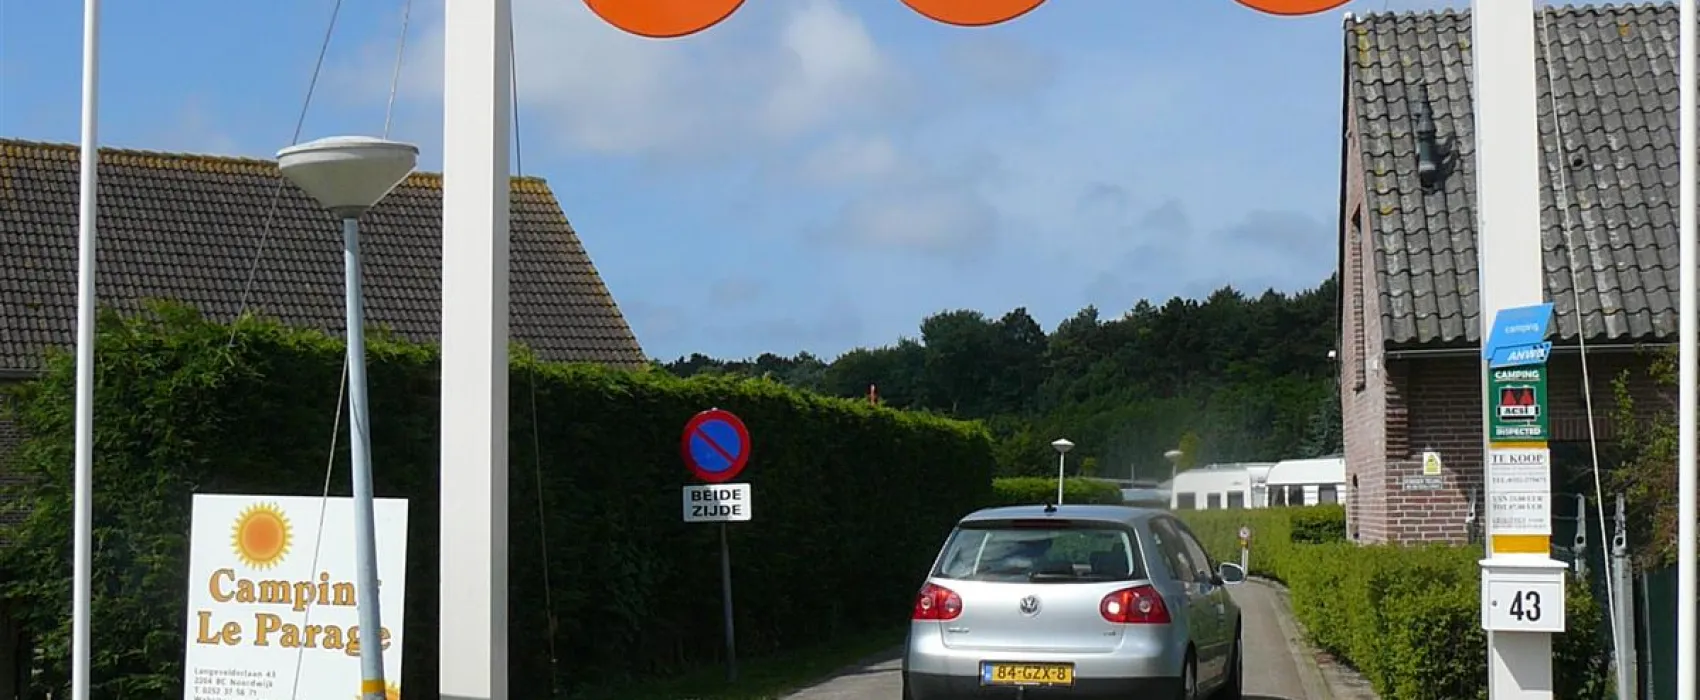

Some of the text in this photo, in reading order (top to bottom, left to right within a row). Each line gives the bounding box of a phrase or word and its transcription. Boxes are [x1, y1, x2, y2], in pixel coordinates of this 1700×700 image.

[1495, 370, 1539, 378] CAMPING
[1495, 427, 1541, 436] INSPECTED
[1492, 455, 1543, 463] TE KOOP
[691, 489, 742, 501] BEIDE
[692, 505, 742, 516] ZIJDE
[208, 568, 382, 613] Campin
[1509, 590, 1541, 622] 43
[196, 611, 242, 646] Le
[998, 665, 1066, 680] 84-GZX-8
[230, 679, 273, 688] Noordwijk
